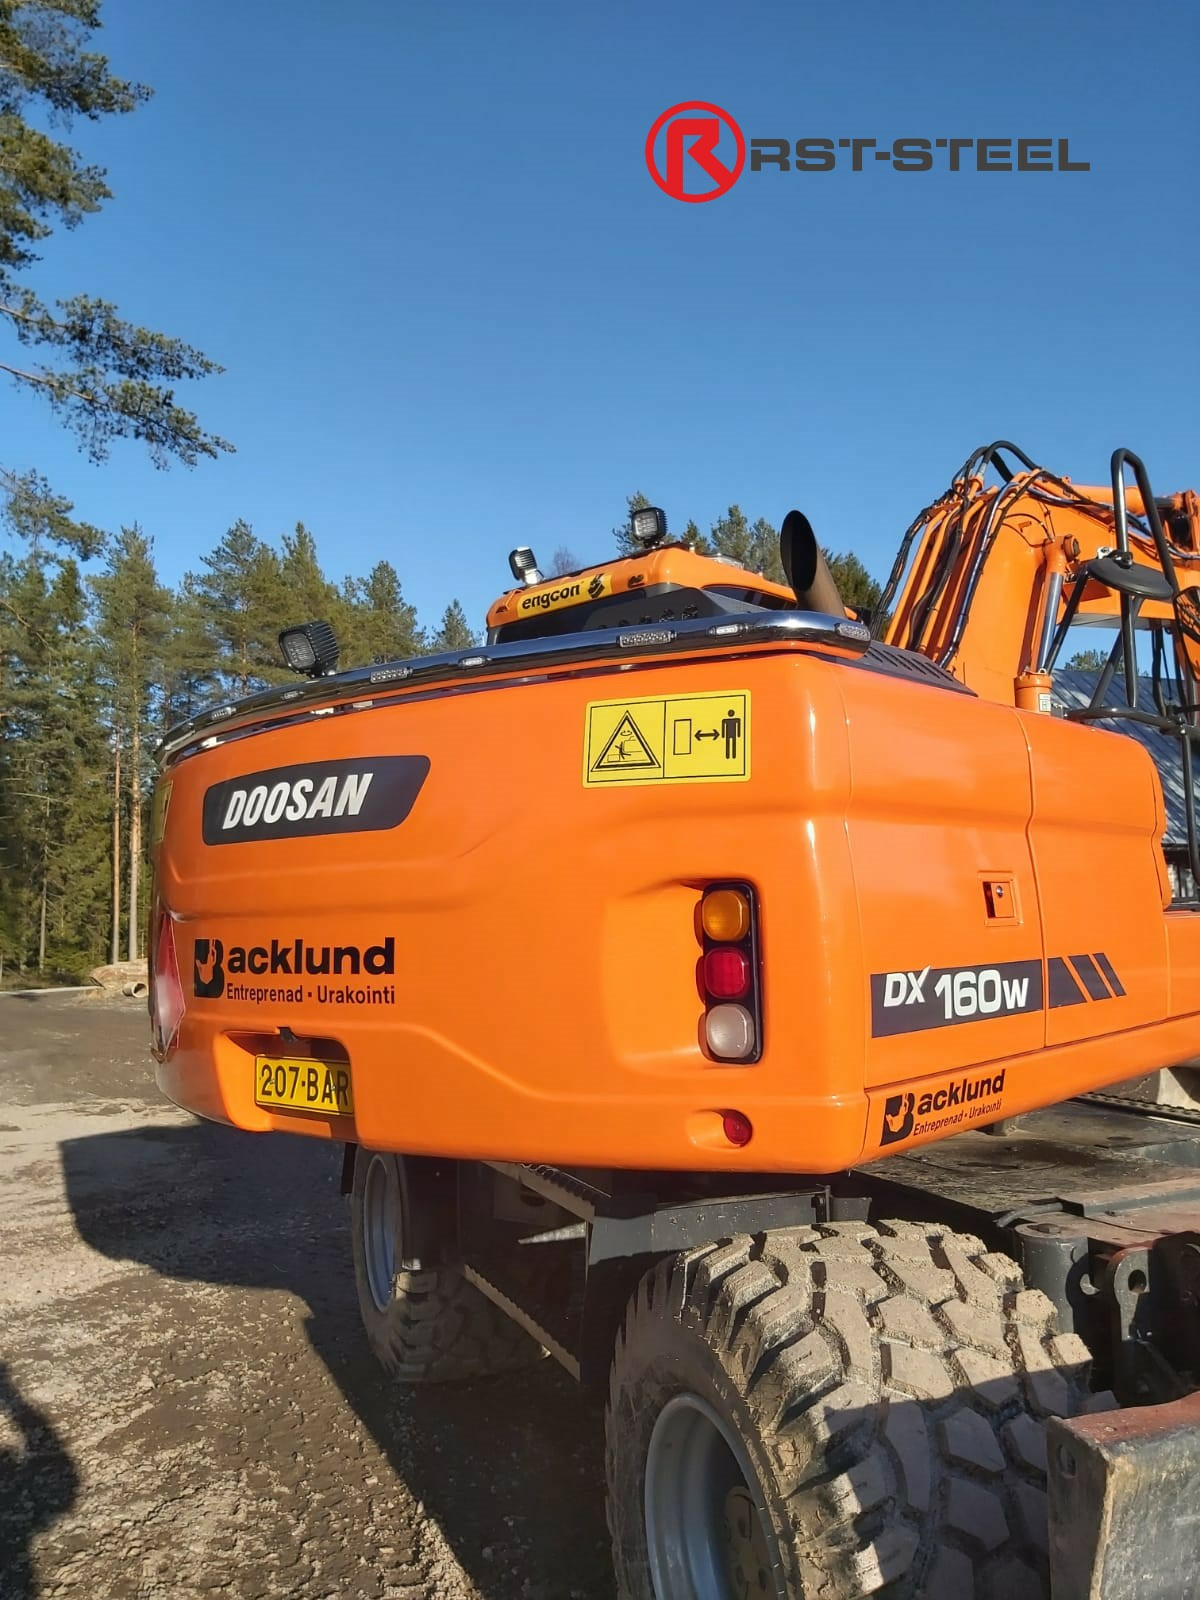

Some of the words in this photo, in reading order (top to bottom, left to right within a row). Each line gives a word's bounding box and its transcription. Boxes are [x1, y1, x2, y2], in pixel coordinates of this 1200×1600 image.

[521, 583, 580, 610] engcon
[222, 773, 374, 830] DOOSAN
[226, 982, 303, 1004] Entreprenad
[317, 985, 396, 1005] Urakointi
[883, 965, 932, 1008] DX
[913, 1109, 964, 1137] Entreprenad
[968, 1098, 1003, 1120] Urakointi
